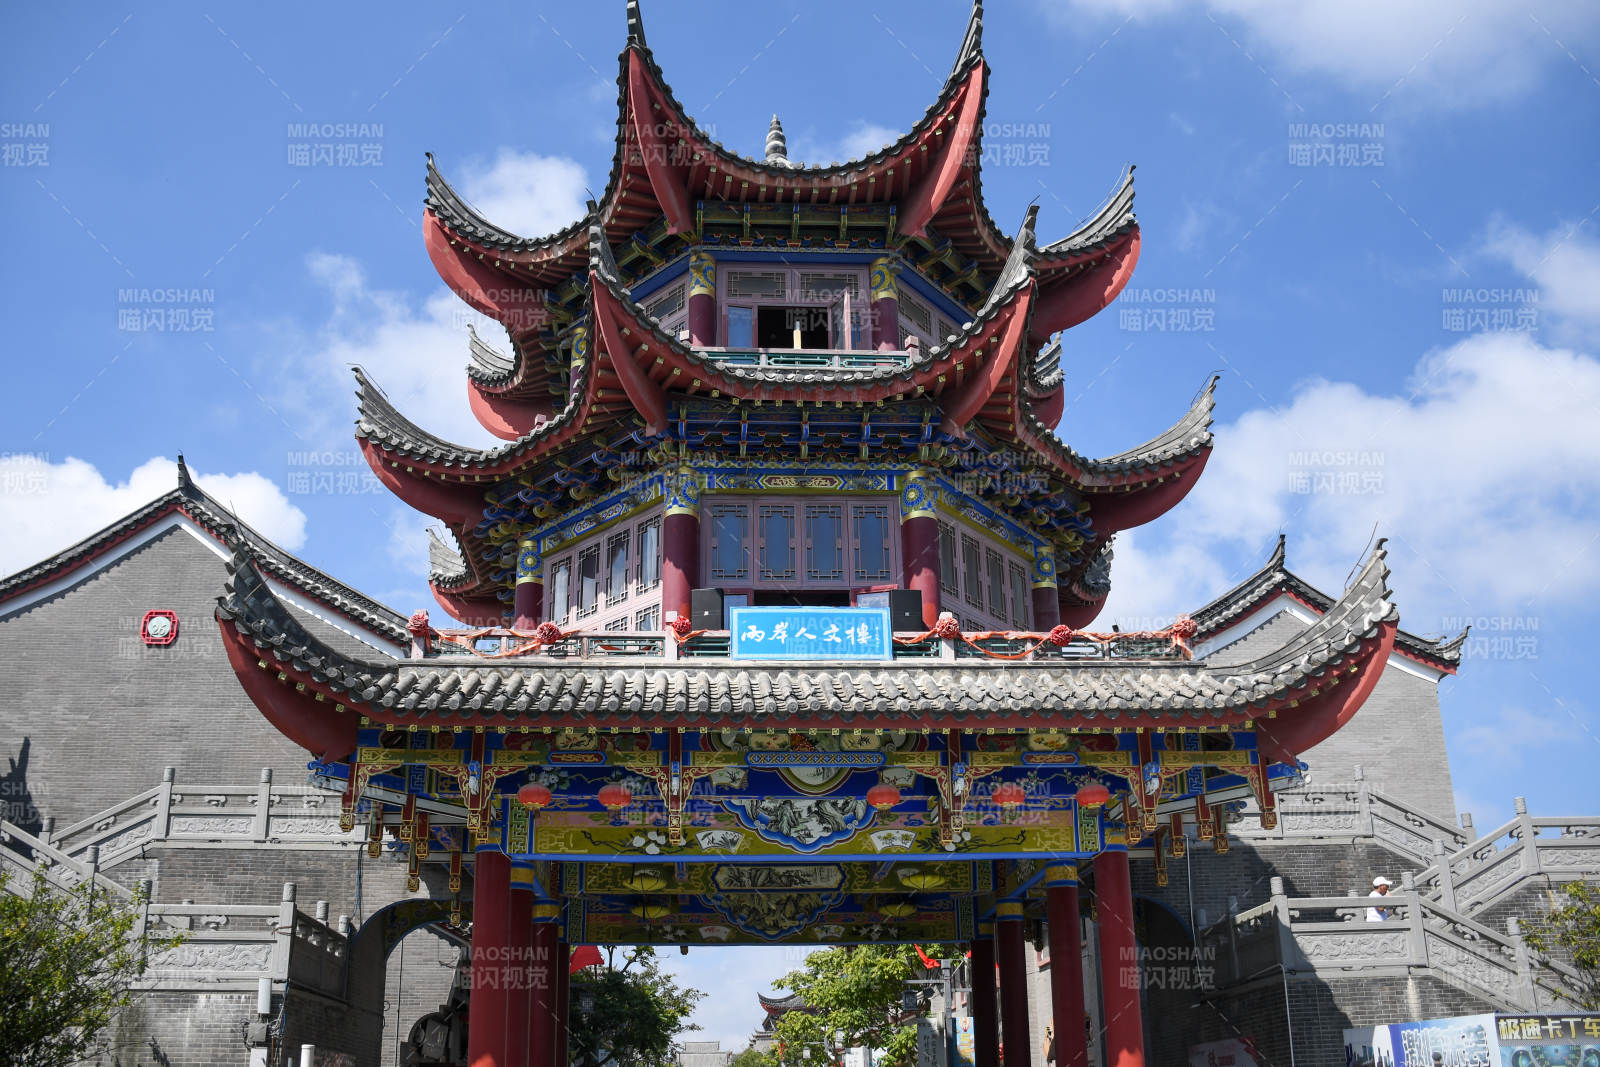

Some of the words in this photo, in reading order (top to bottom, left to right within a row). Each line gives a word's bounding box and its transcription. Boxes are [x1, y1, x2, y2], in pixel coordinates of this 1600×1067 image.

[151, 623, 168, 636] 26
[1499, 1018, 1600, 1040] 极速卡丁车
